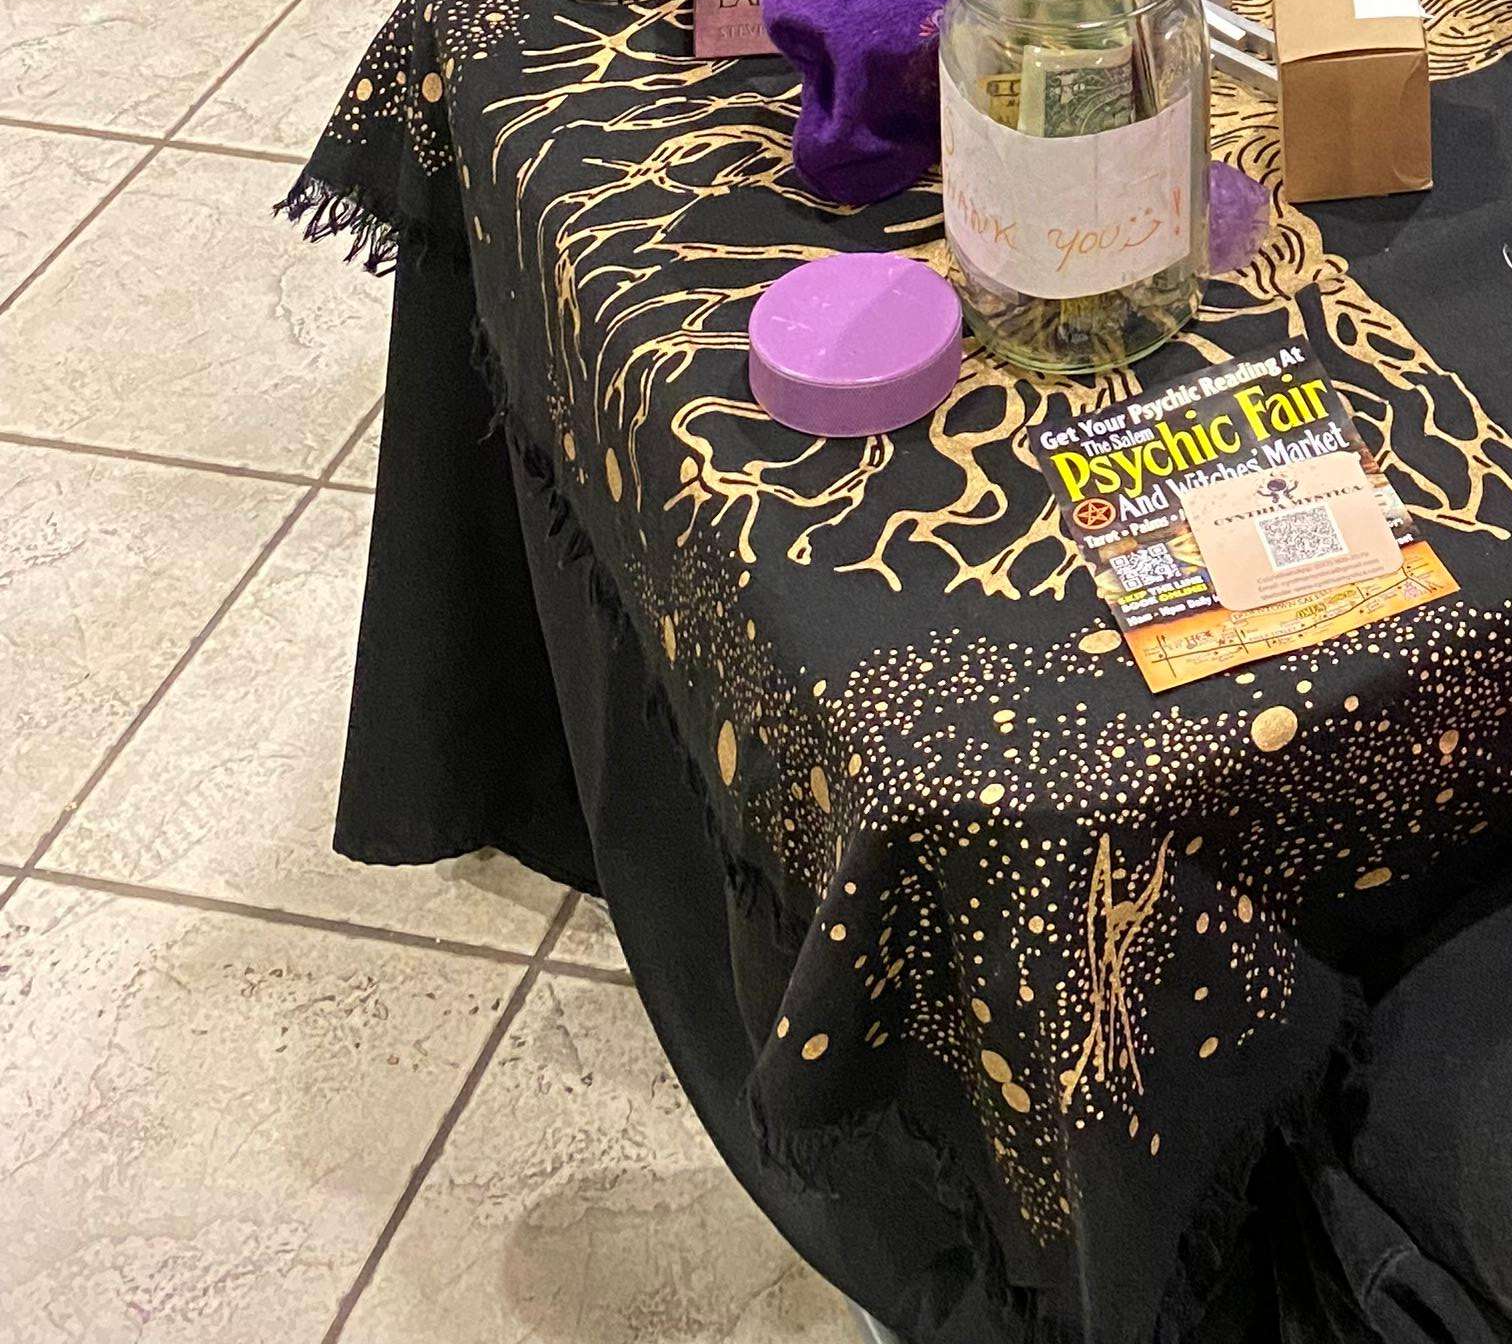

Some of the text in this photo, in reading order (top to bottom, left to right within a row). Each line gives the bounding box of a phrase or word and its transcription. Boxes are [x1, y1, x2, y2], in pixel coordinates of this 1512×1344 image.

[1040, 346, 1306, 450] Get Your Psychic Reading At
[1050, 372, 1331, 503] Psychic Fair
[1081, 427, 1156, 457] The Salem
[1118, 485, 1170, 522] And
[1261, 422, 1351, 471] Market
[1083, 529, 1121, 549] Tarot
